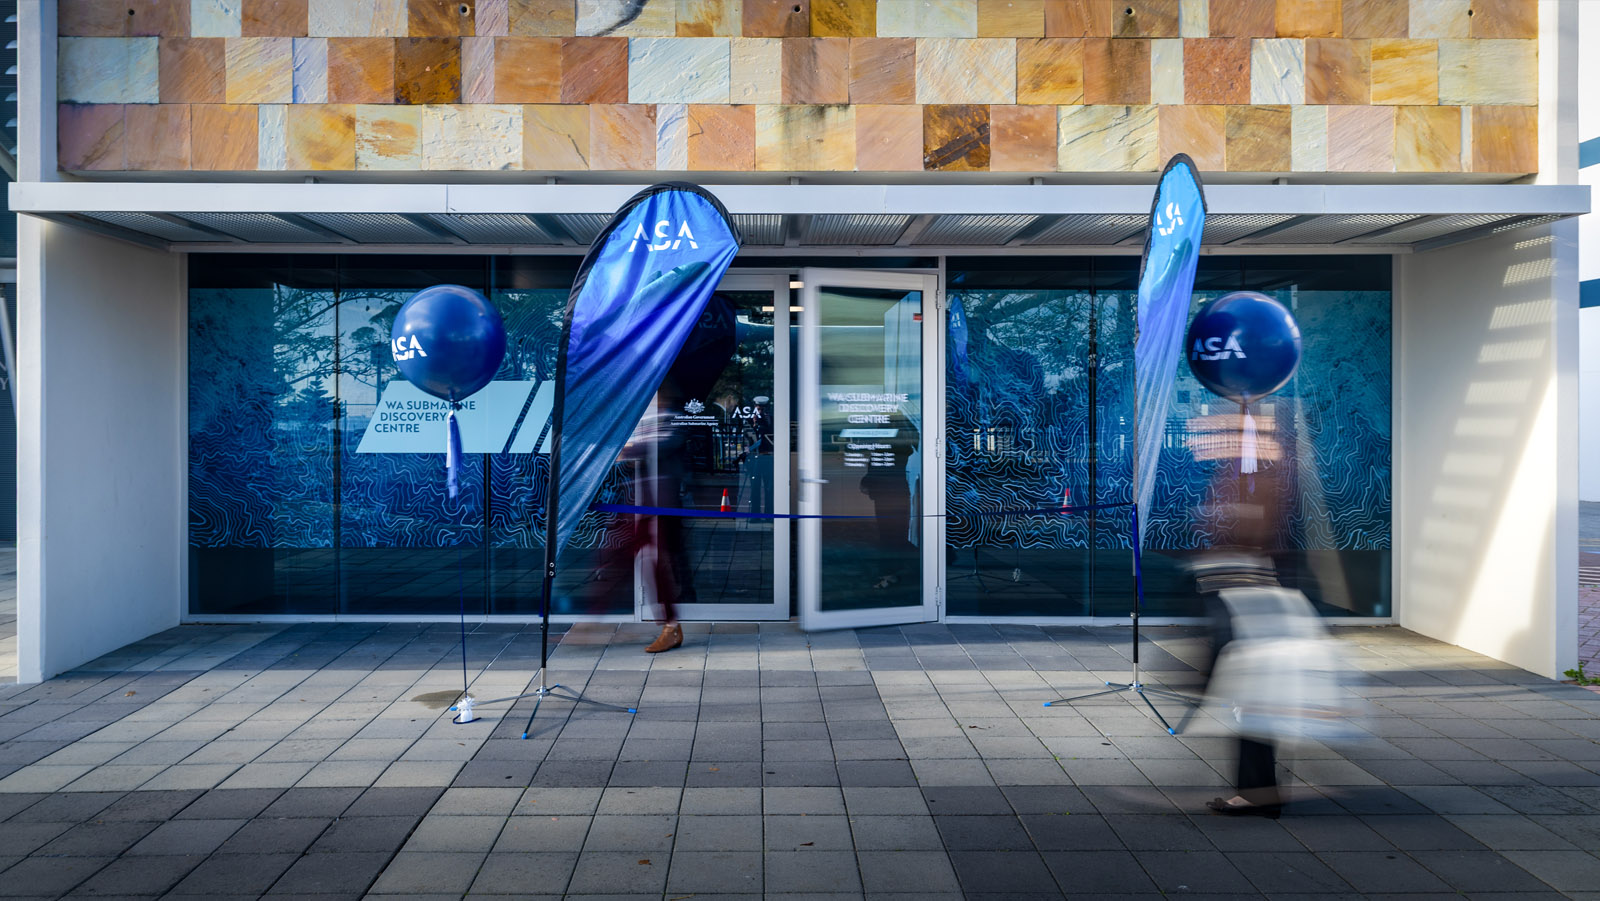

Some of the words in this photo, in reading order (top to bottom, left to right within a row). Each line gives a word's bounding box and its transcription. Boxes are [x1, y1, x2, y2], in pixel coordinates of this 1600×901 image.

[628, 219, 699, 253] ASA
[1191, 335, 1247, 361] ASA
[385, 400, 404, 410] WA
[380, 412, 447, 422] DISCOVERY
[731, 406, 762, 419] ASA
[374, 423, 420, 433] CENTRE
